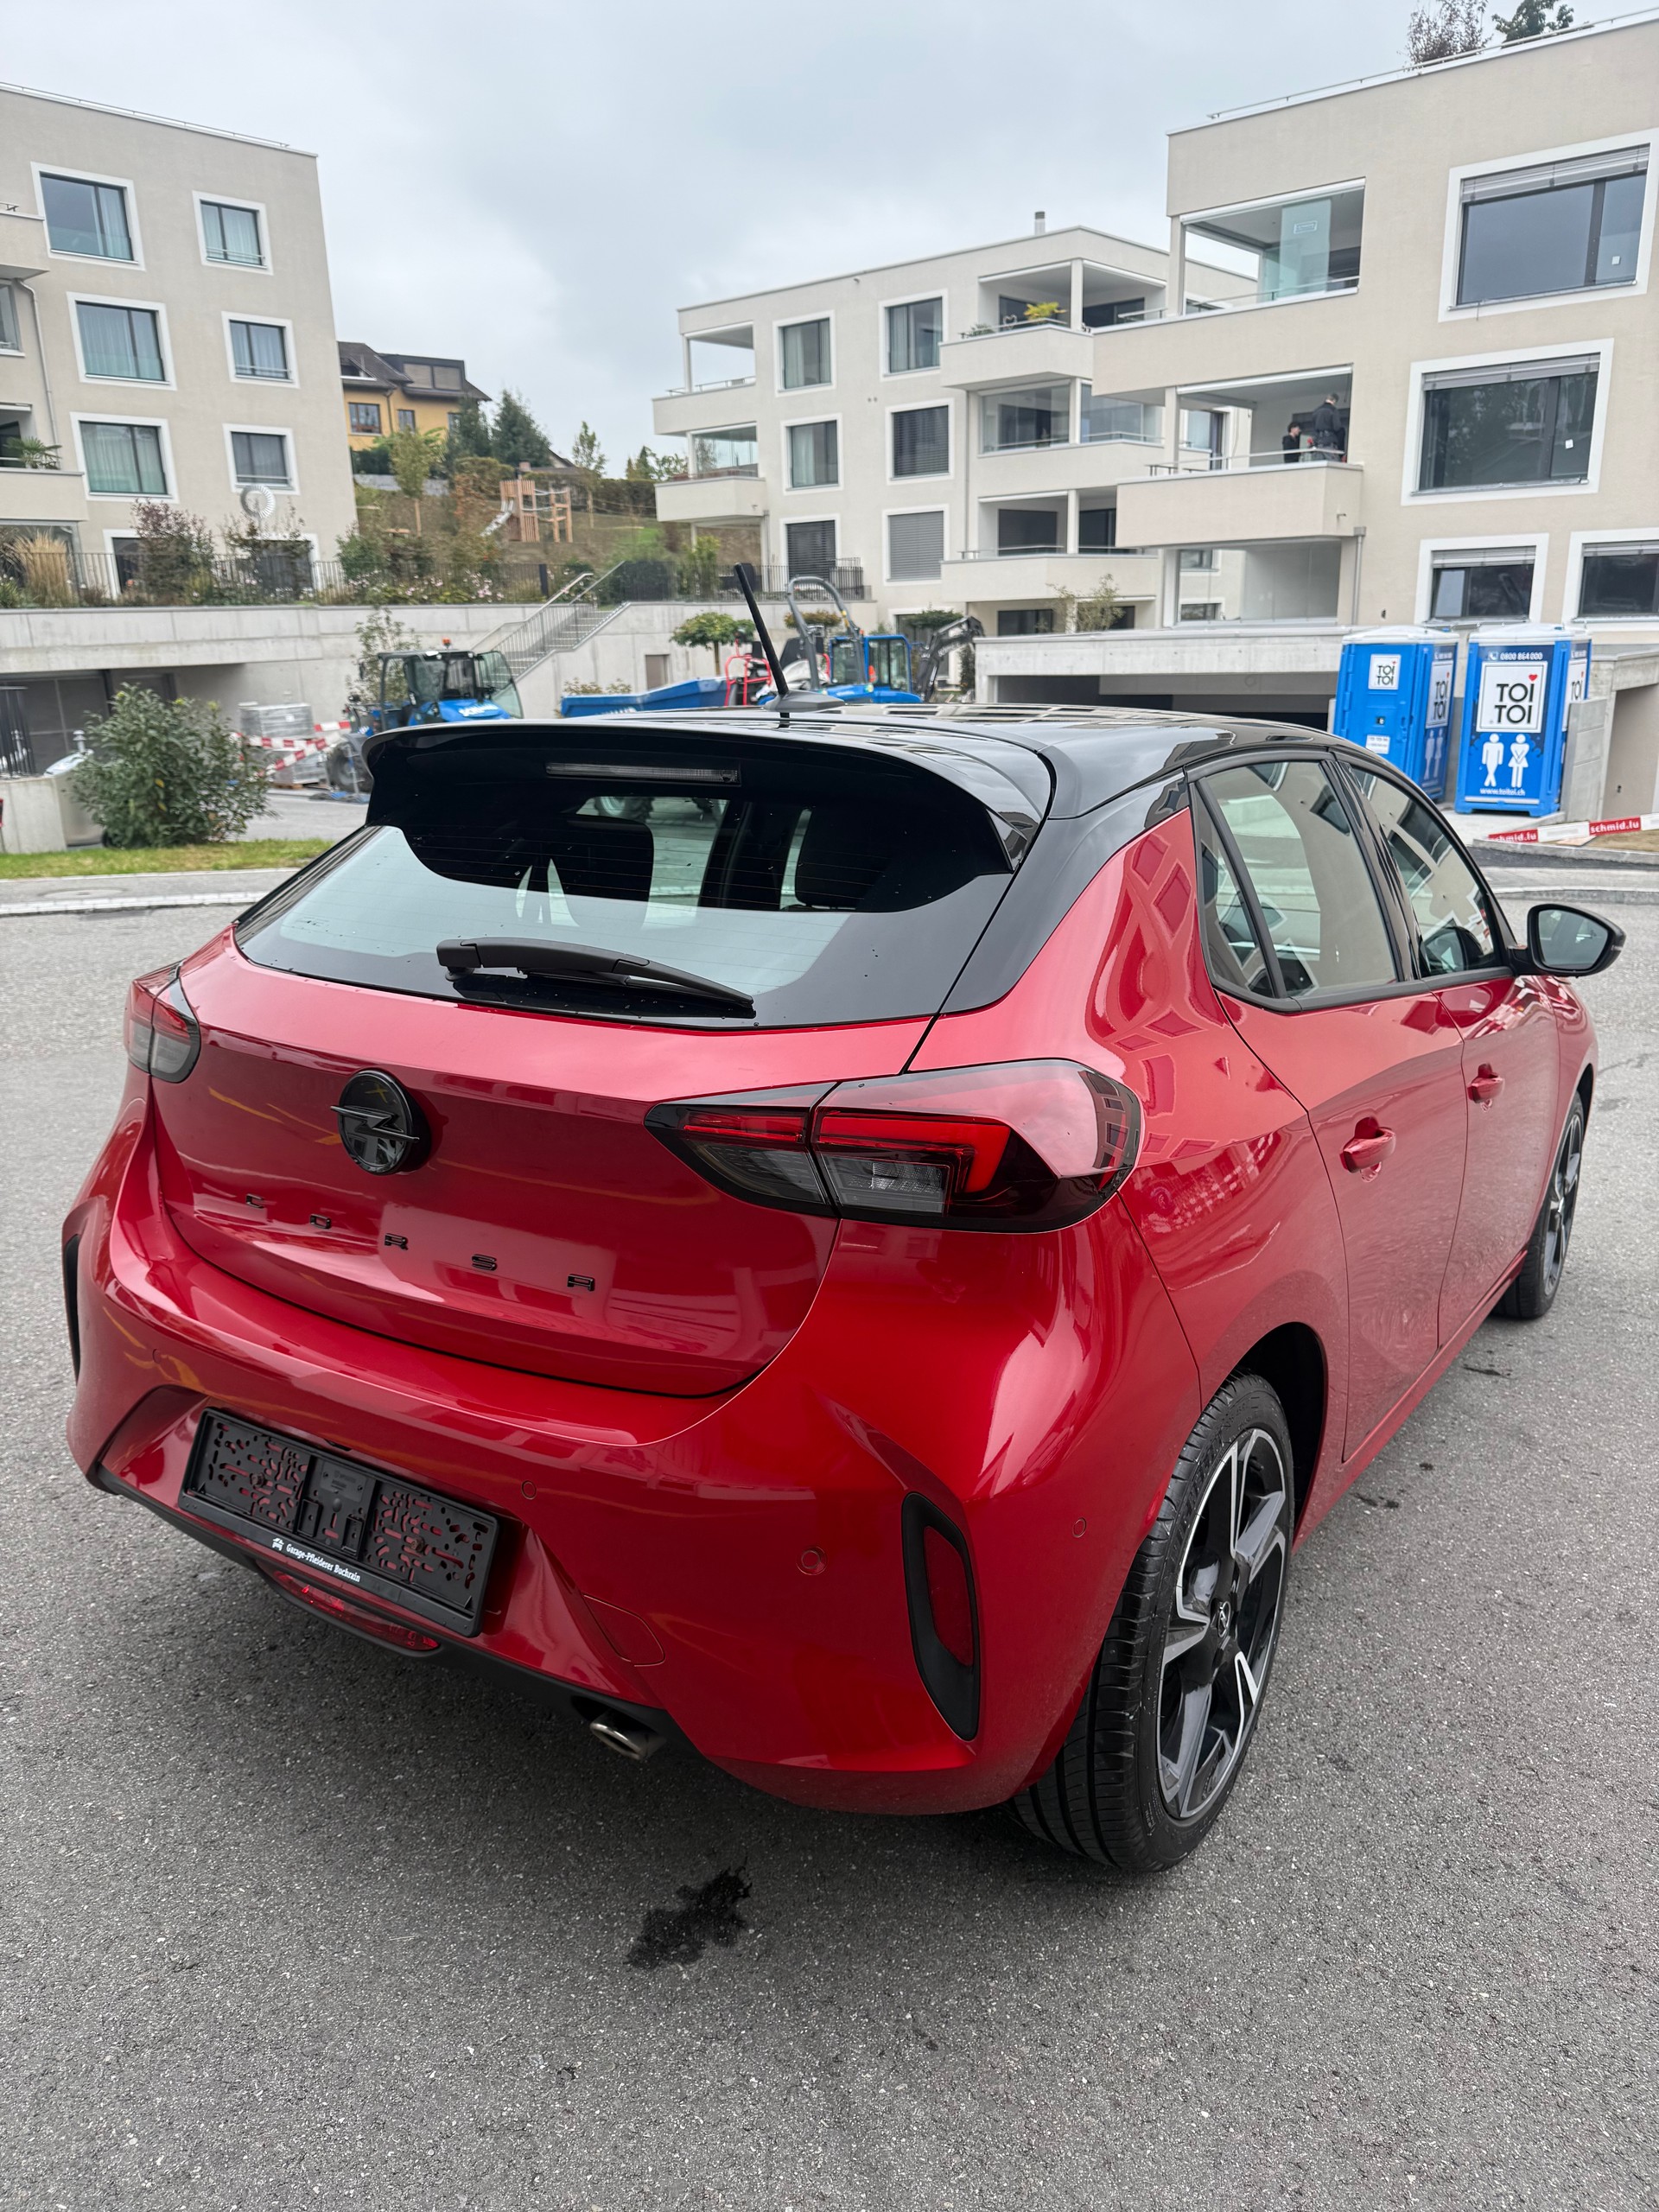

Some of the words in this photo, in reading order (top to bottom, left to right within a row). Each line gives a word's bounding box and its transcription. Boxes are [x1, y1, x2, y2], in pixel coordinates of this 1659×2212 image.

[1377, 664, 1395, 675] TOI
[1376, 676, 1394, 685] TOI
[1436, 680, 1449, 700] TOI
[1497, 683, 1535, 702] TOI
[1433, 700, 1447, 720] TOI
[1494, 705, 1532, 724] TOI
[1479, 787, 1526, 796] www.toitoi.ch
[1590, 820, 1640, 834] schmid.lu
[245, 1193, 596, 1292] CORSA
[334, 1564, 361, 1582] Buchrain
